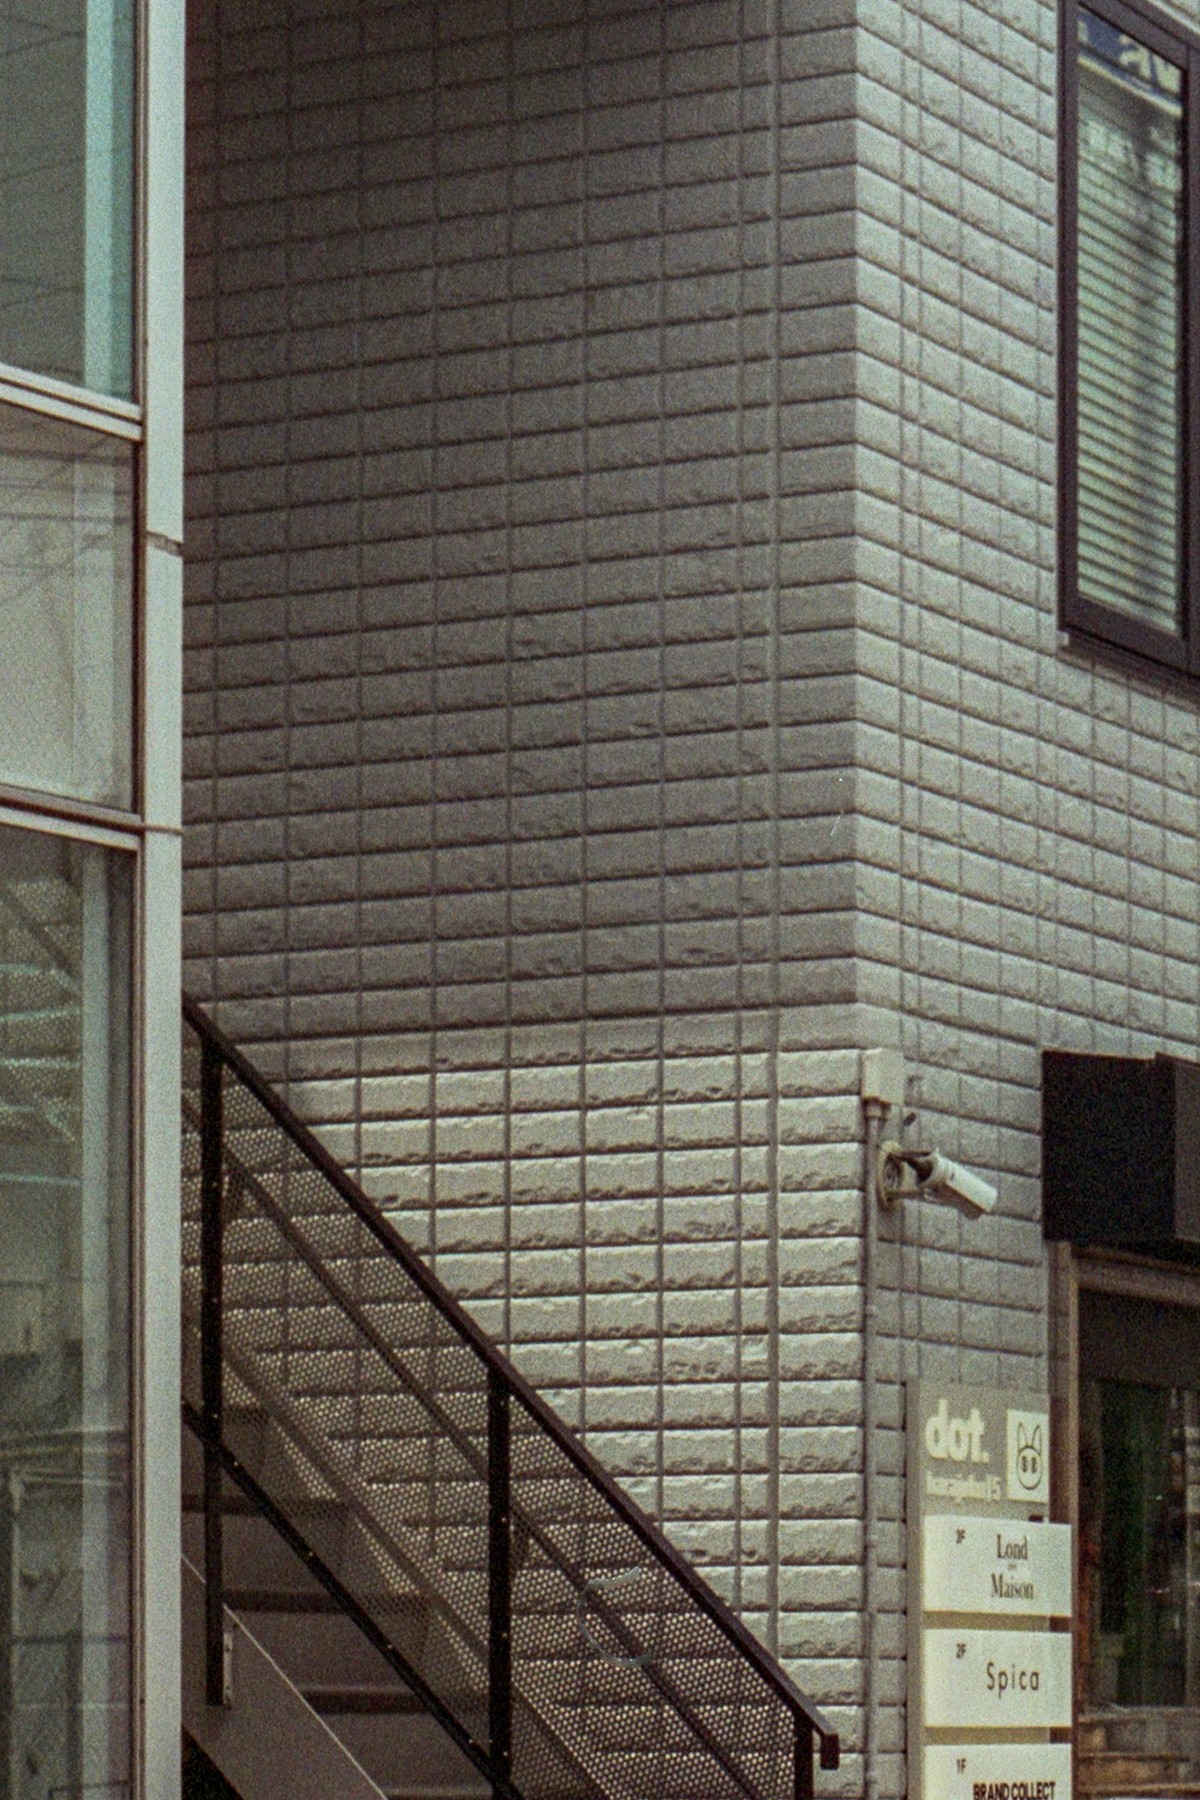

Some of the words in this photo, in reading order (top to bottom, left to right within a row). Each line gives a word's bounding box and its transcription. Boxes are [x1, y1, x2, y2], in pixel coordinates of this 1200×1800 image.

[997, 1533, 1028, 1560] Lond
[991, 1573, 1034, 1600] Maison
[956, 1643, 967, 1659] 2F
[986, 1661, 1040, 1700] Spica
[957, 1758, 967, 1776] 1F
[1011, 1781, 1056, 1800] COLLECT
